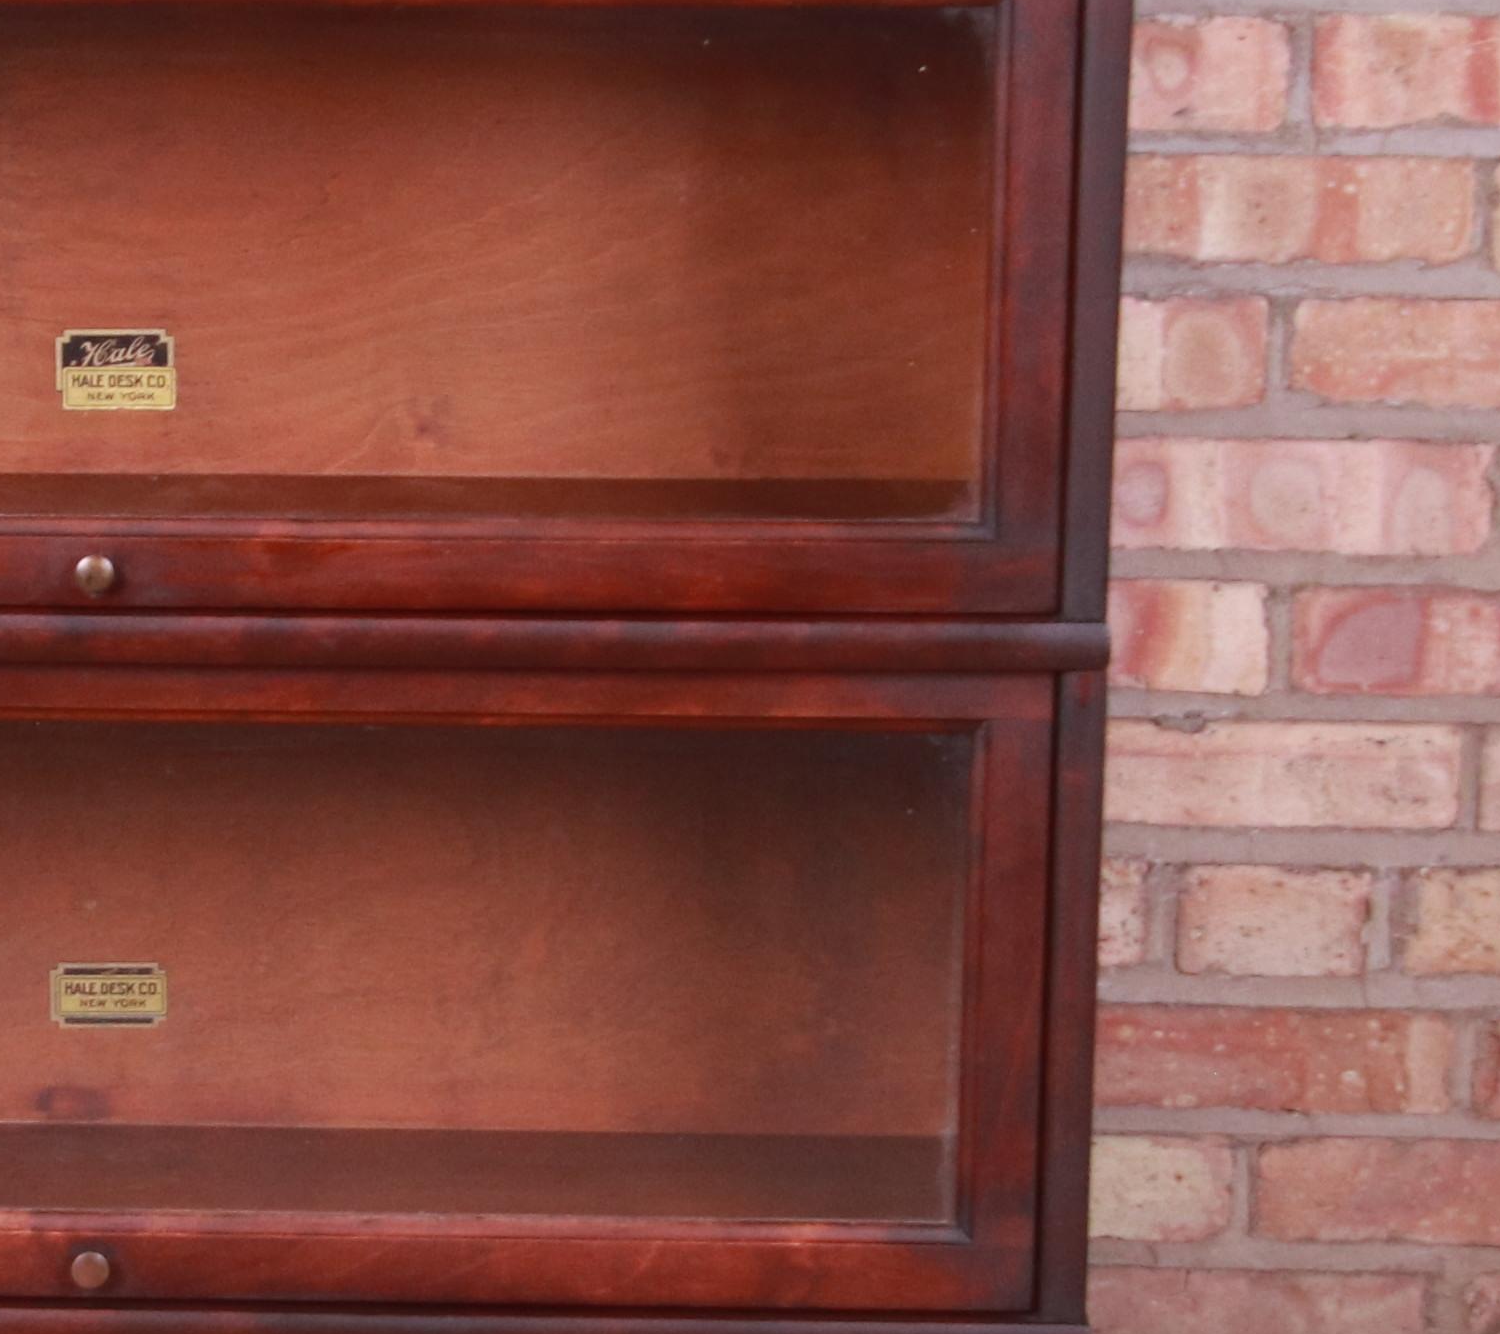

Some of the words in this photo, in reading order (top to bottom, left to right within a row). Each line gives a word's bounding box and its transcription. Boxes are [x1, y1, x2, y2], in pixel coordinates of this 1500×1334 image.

[70, 336, 156, 367] Hale
[71, 374, 104, 387] HALE
[108, 374, 143, 387] DESK
[87, 391, 114, 400] NEW
[120, 391, 155, 401] YORK
[64, 982, 97, 995] HALE
[100, 982, 135, 995] DESK
[79, 998, 107, 1007] NEW
[114, 998, 147, 1008] YORK
